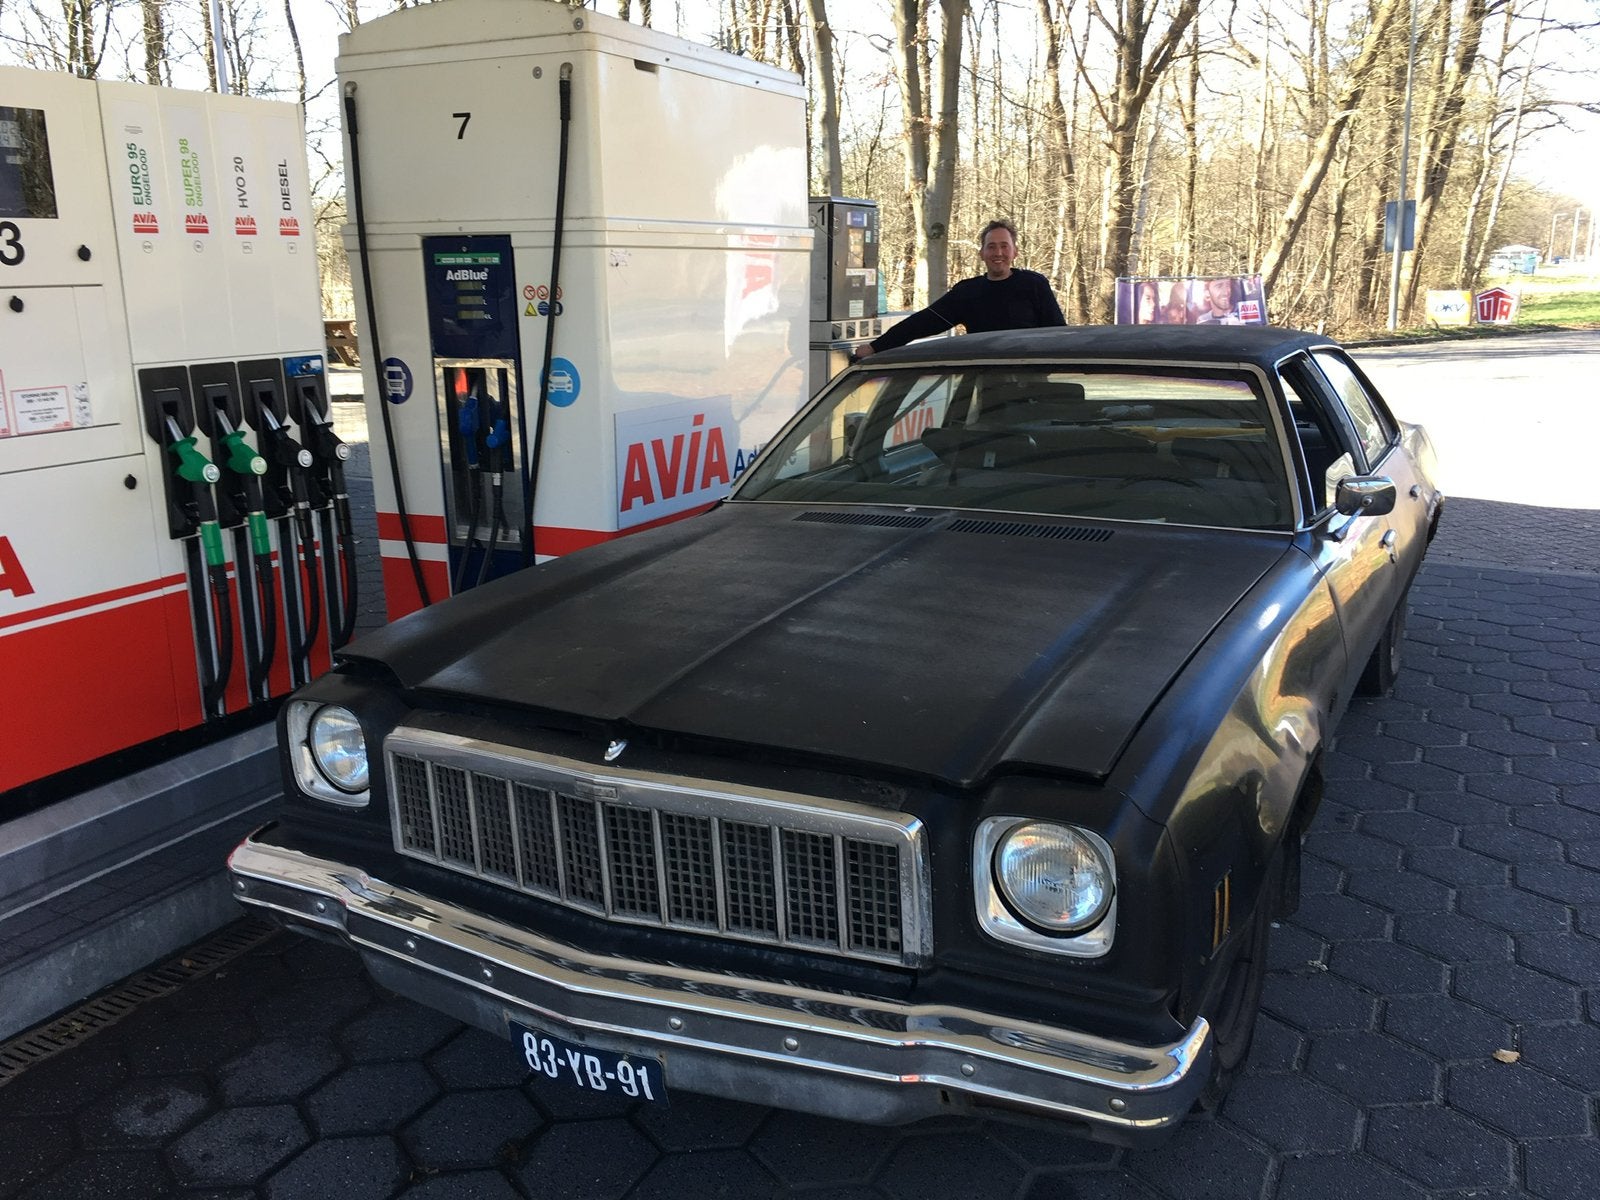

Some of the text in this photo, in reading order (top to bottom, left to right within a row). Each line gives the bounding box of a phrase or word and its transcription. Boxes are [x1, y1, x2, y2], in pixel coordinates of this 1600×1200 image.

[452, 112, 471, 140] 7
[127, 142, 137, 160] 95
[179, 138, 195, 207] SUPER 98
[130, 165, 144, 206] EURO
[139, 148, 153, 206] ONGELOOD
[191, 152, 204, 207] ONGELOOD
[234, 156, 249, 208] HVO 20
[278, 159, 292, 211] DIESEL
[133, 212, 158, 224] AVIA
[185, 212, 209, 225] AVIA
[235, 215, 257, 227] AVIA
[279, 216, 299, 228] AVIA
[817, 205, 826, 226] 1
[0, 221, 25, 266] 3
[620, 413, 730, 512] AVIA
[522, 1031, 655, 1101] 83-YB-91
